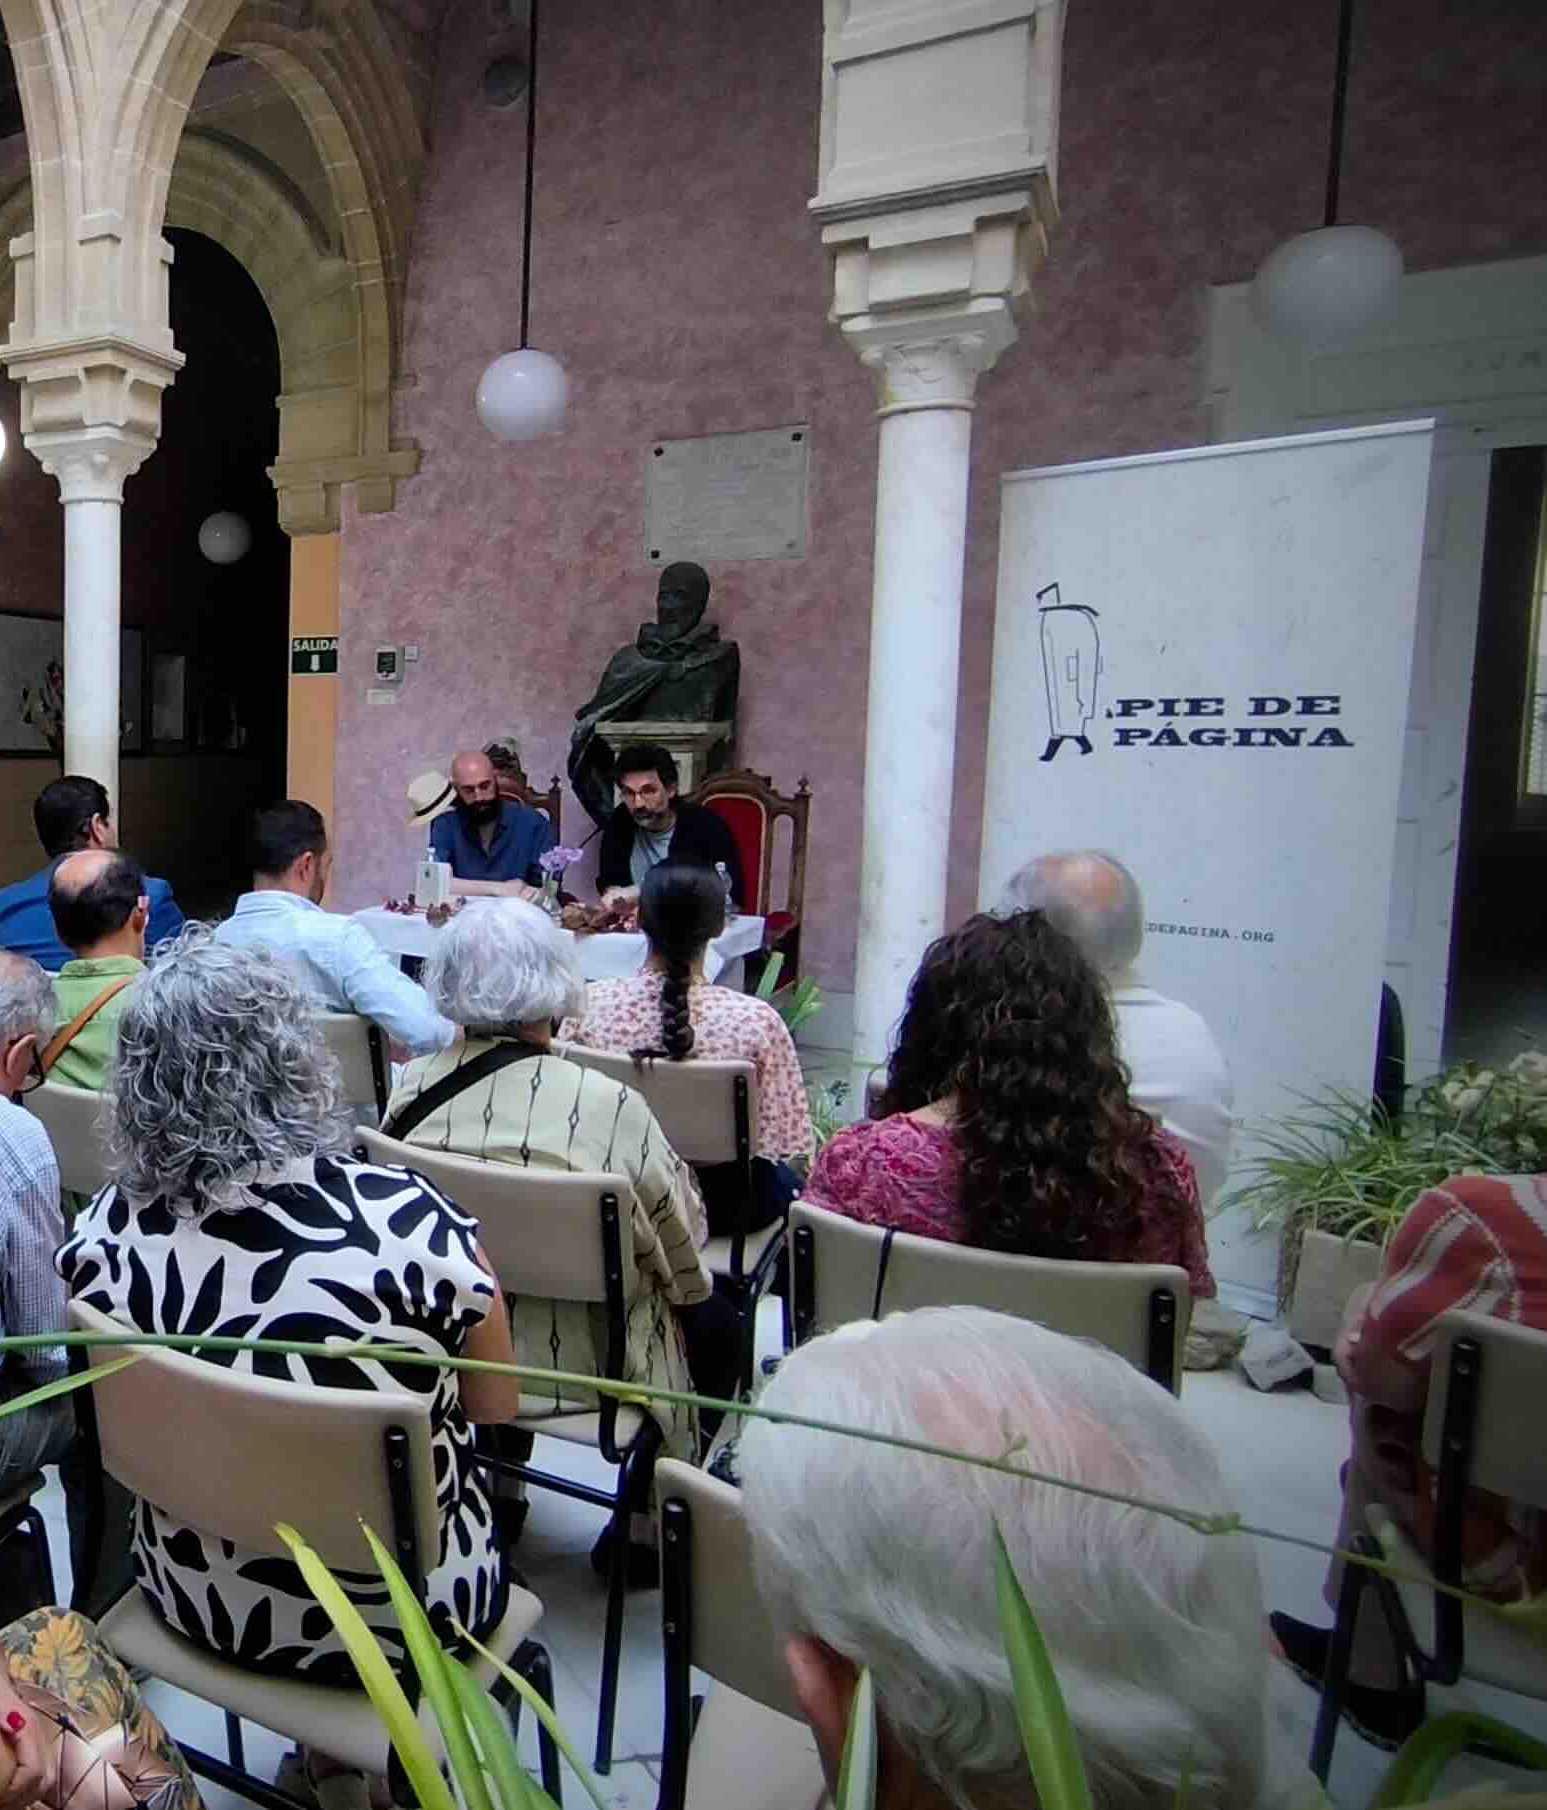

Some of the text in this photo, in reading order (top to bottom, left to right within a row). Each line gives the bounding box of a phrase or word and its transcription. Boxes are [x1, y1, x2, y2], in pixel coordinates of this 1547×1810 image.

[293, 639, 340, 652] SALIDA
[1116, 696, 1341, 717] PIE DE
[1113, 721, 1355, 747] PÁGINA
[1145, 922, 1275, 943] DEPAGINA.ORG
